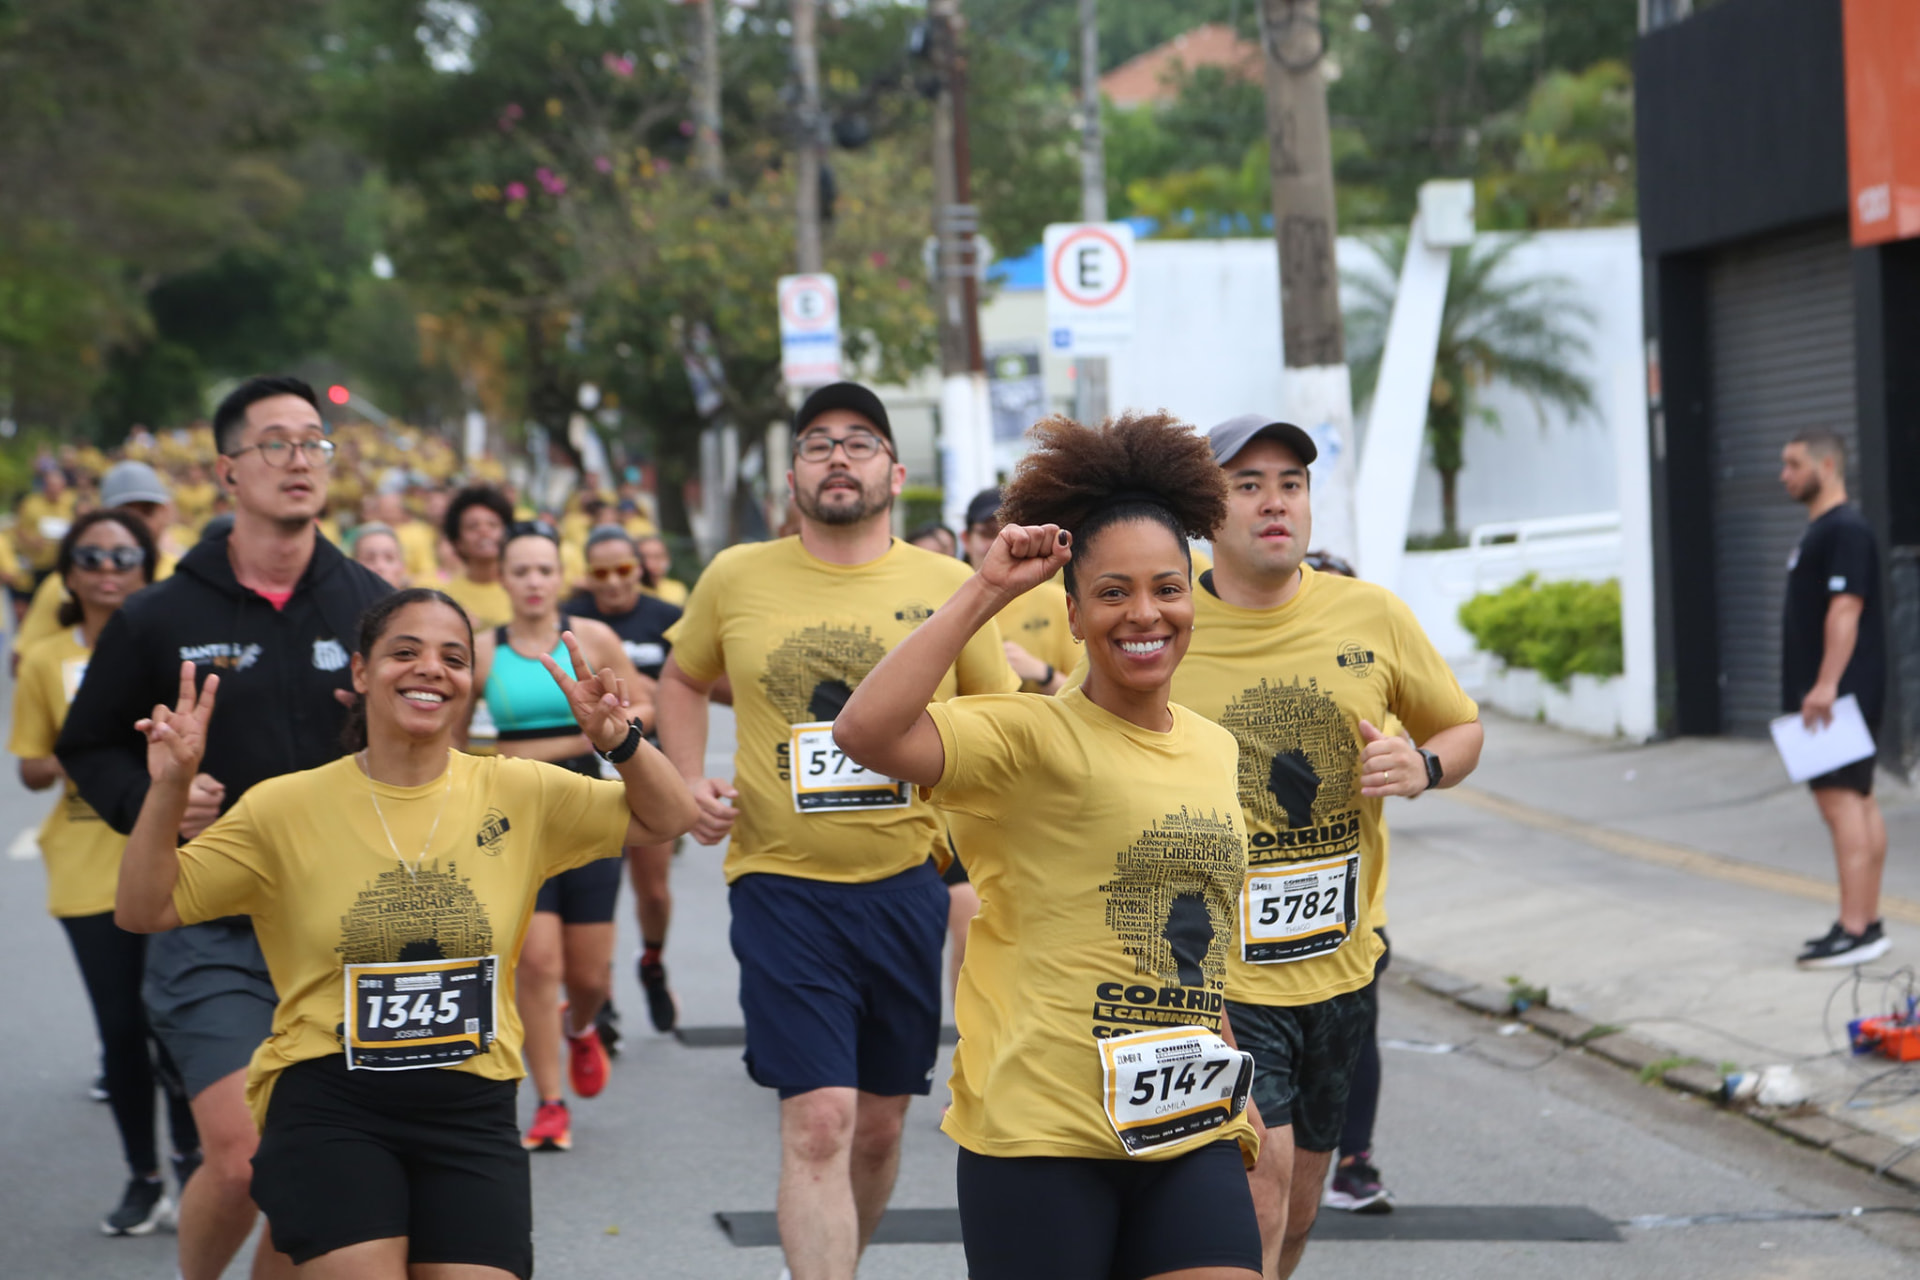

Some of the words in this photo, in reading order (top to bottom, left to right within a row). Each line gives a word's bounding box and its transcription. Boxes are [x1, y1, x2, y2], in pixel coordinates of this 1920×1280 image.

[1078, 249, 1101, 289] E
[1343, 652, 1369, 665] 20/11
[1246, 709, 1319, 727] LIBERDADE
[479, 822, 505, 844] 20/11
[1143, 830, 1184, 840] EVOLUIR
[1193, 832, 1217, 841] AMOR
[1193, 840, 1212, 849] PAZ
[1163, 847, 1232, 863] LIBERDADE
[1187, 861, 1238, 873] PROGRESSO
[1099, 884, 1153, 894] IGUALDADE
[377, 898, 456, 915] LIBERDADE
[1106, 898, 1149, 907] VALORES
[1258, 886, 1339, 926] 5782
[1117, 904, 1149, 915] AMOR
[1117, 932, 1147, 941] UNIÃO
[366, 989, 462, 1029] 1345
[393, 1028, 434, 1039] JOSINEA
[1155, 1042, 1201, 1054] CORRIDA
[1129, 1058, 1231, 1107] 5147
[1155, 1099, 1187, 1116] CAMILA
